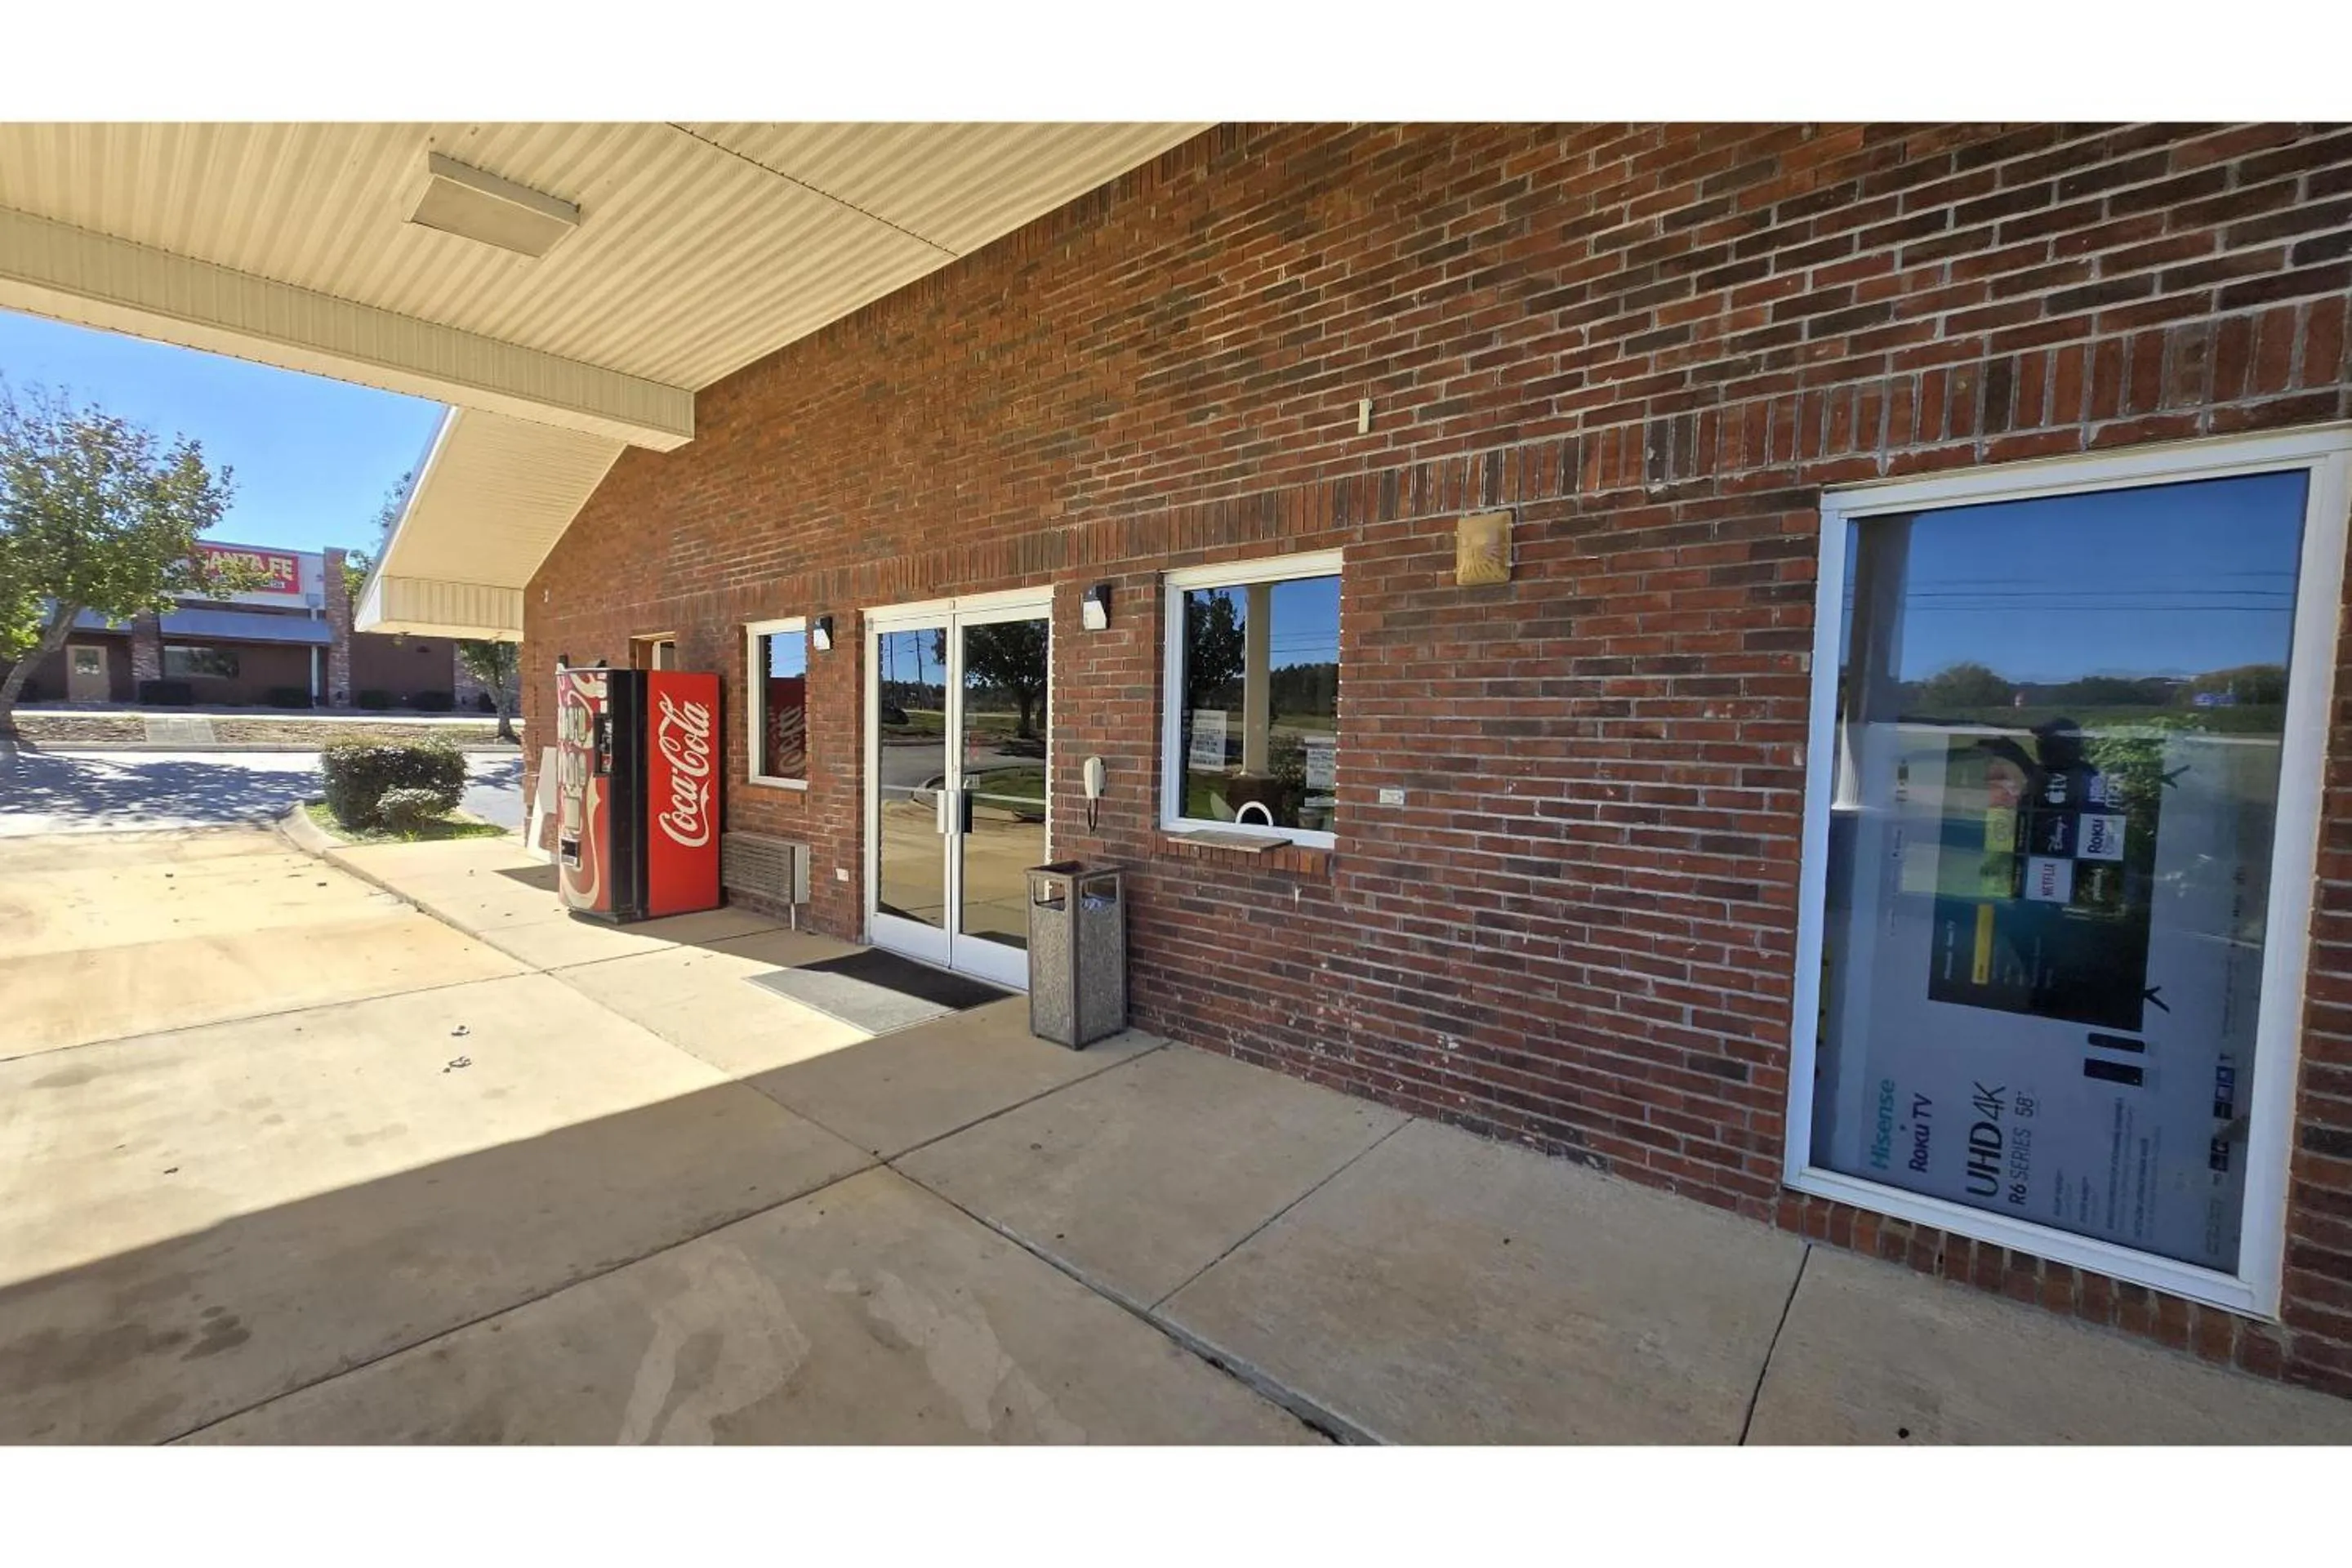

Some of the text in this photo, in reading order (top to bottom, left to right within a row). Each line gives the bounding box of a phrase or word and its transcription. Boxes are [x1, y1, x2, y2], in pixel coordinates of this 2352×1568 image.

[268, 556, 294, 581] FE
[658, 691, 710, 847] Coca-Cola
[2042, 863, 2056, 897] NETFLIX
[1870, 1078, 1895, 1170] Hisense
[1909, 1092, 1933, 1174] Roku TV
[2009, 1127, 2032, 1183] SERIES
[2008, 1183, 2027, 1206] R6
